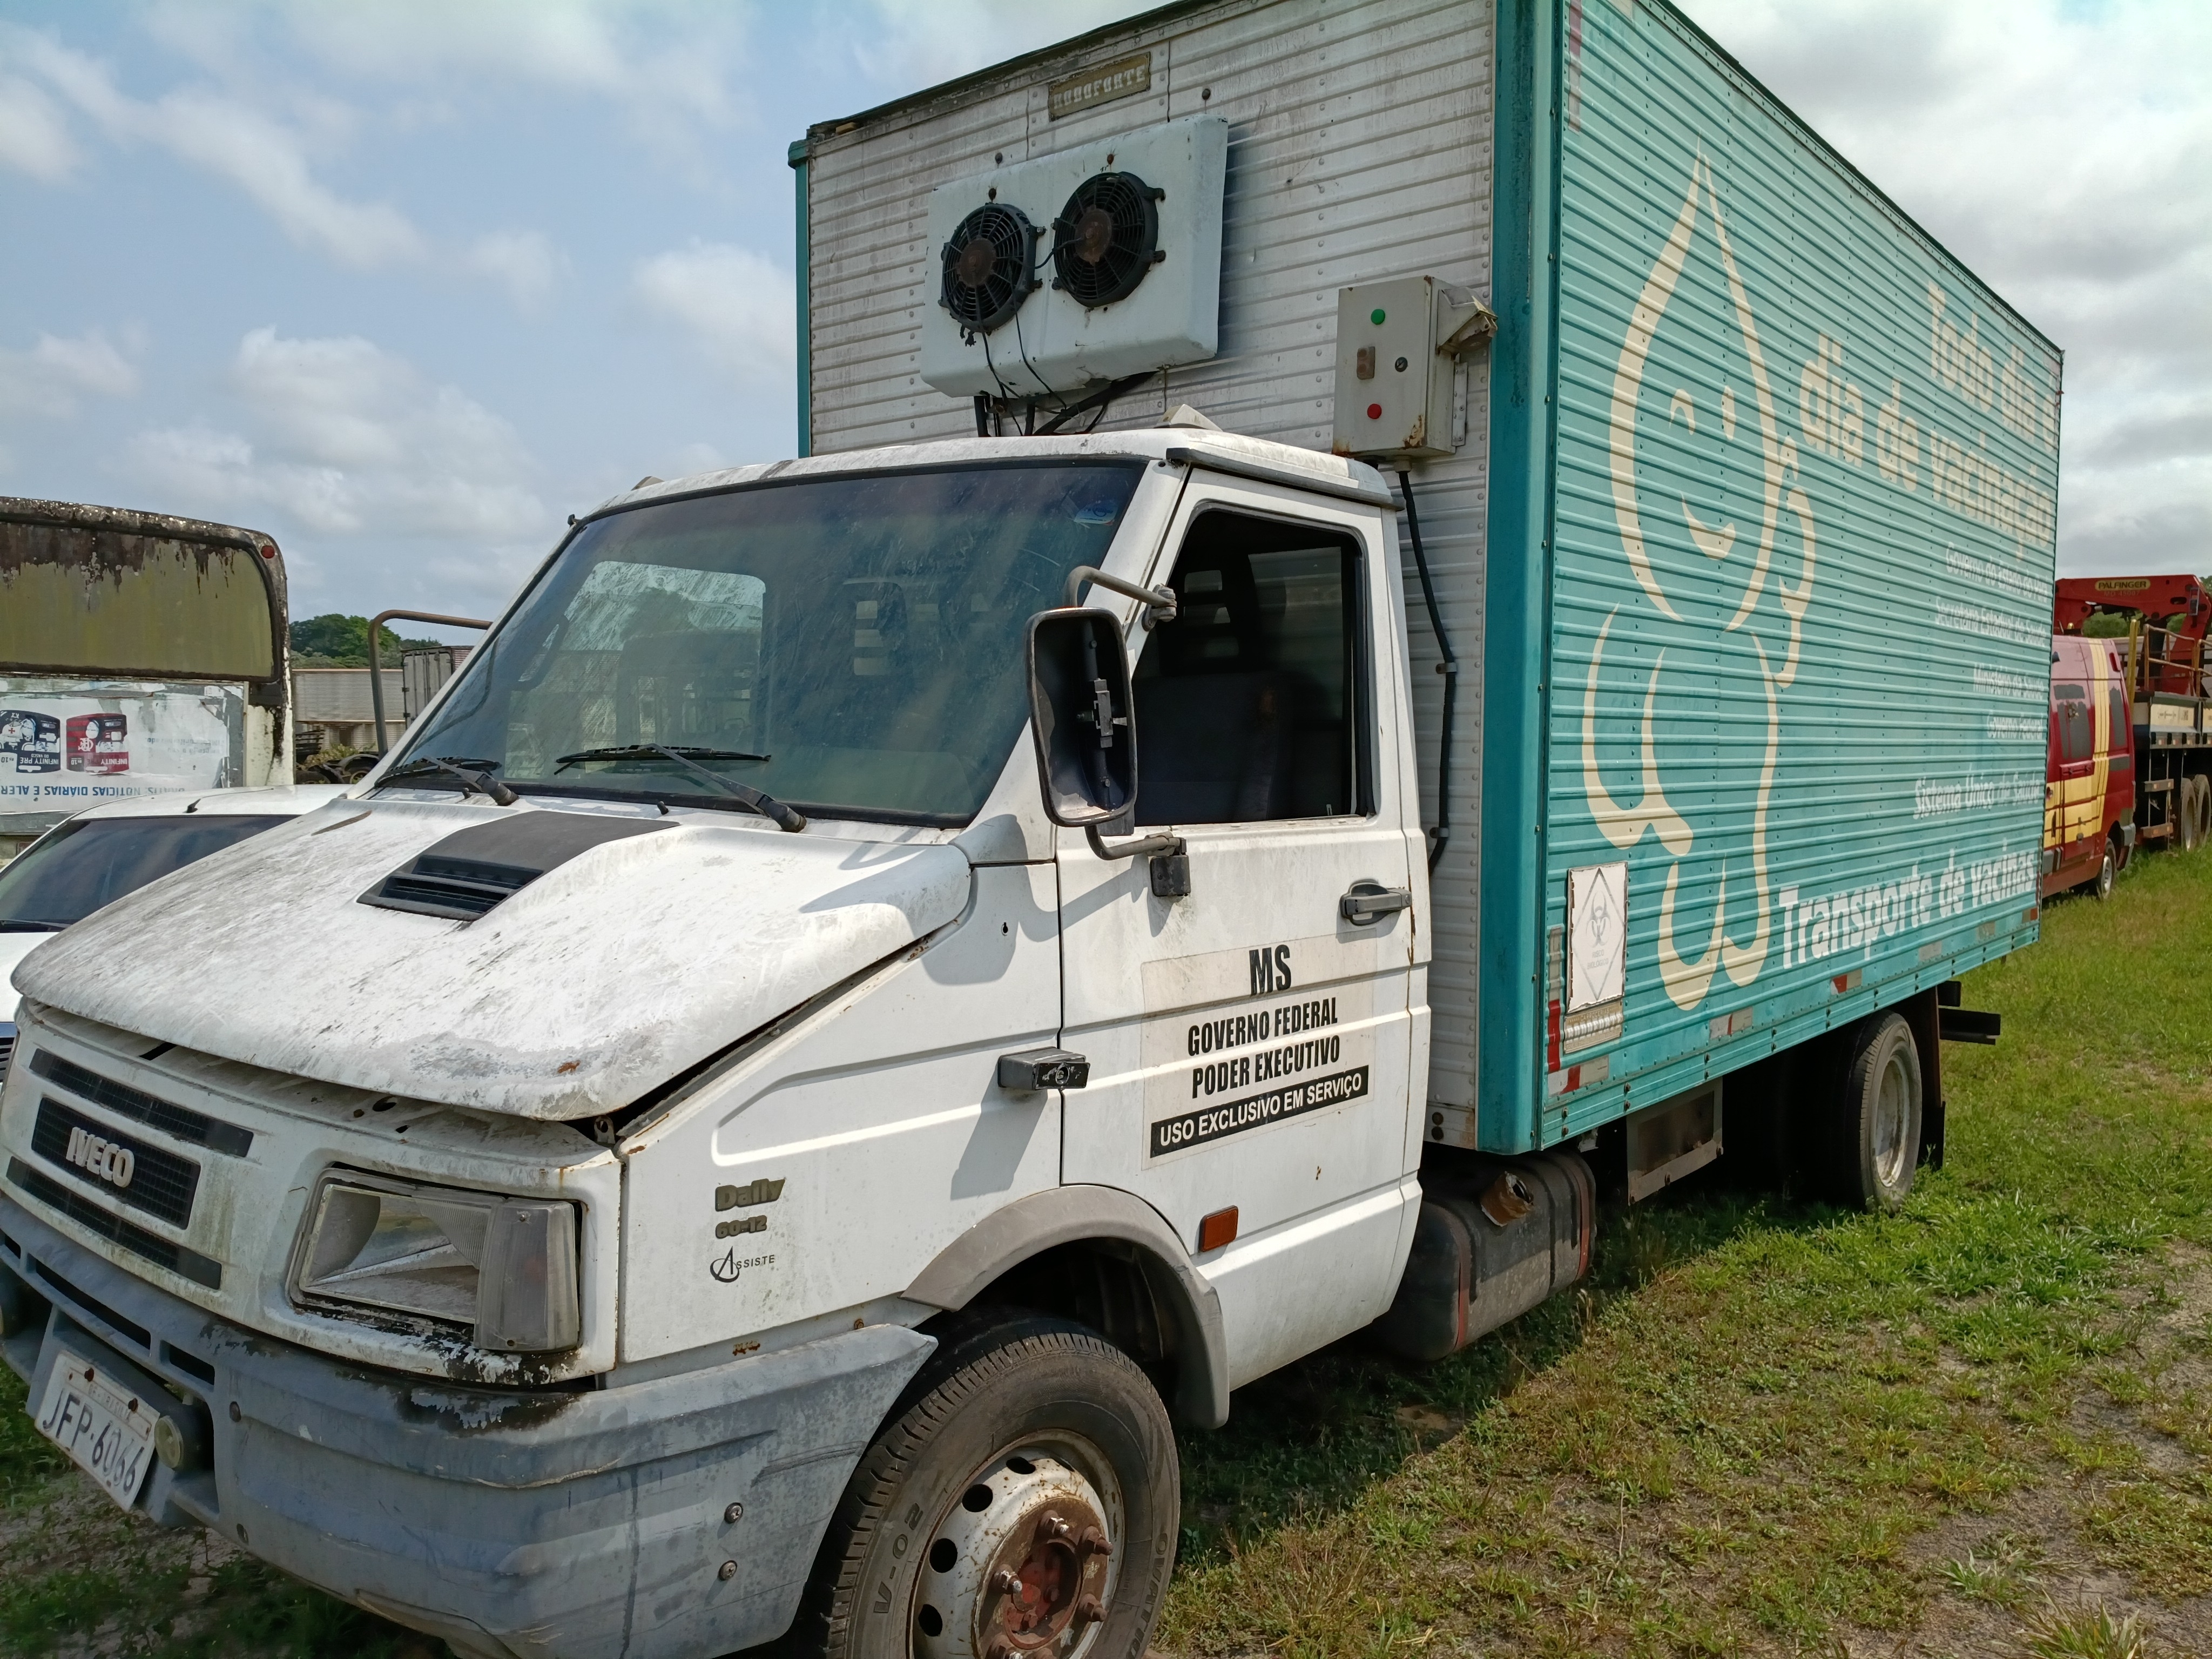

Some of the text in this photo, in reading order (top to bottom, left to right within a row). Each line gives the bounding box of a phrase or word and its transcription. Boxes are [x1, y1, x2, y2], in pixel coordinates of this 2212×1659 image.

[1054, 64, 1145, 109] RODOFORTE
[1927, 280, 1993, 413] Todo
[2001, 343, 2035, 443] dia
[1799, 332, 2052, 562] dia de vacinação
[1946, 541, 1984, 583] Governo
[1985, 555, 1995, 586] do
[2098, 581, 2147, 589] PALFINGER
[1935, 596, 1979, 632] Secretaria
[1980, 606, 2014, 639] Estadual
[1987, 709, 2043, 740] Governo Federal
[33, 786, 40, 795] E
[44, 786, 88, 797] DIÁRIAS
[93, 786, 140, 797] NOTÍCIAS
[1913, 776, 1962, 820] Sistema
[1778, 837, 2035, 969] Transporte de vacinas
[1249, 944, 1292, 996] MS
[1188, 997, 1338, 1056] GOVERNO FEDERAL
[1192, 1035, 1340, 1099] PODER EXECUTIVO
[1160, 1073, 1361, 1146] USO EXCLUSIVO EM SERVIÇO
[66, 1127, 135, 1188] IVECO
[715, 1178, 786, 1212] Daily
[715, 1215, 767, 1239] 60-12
